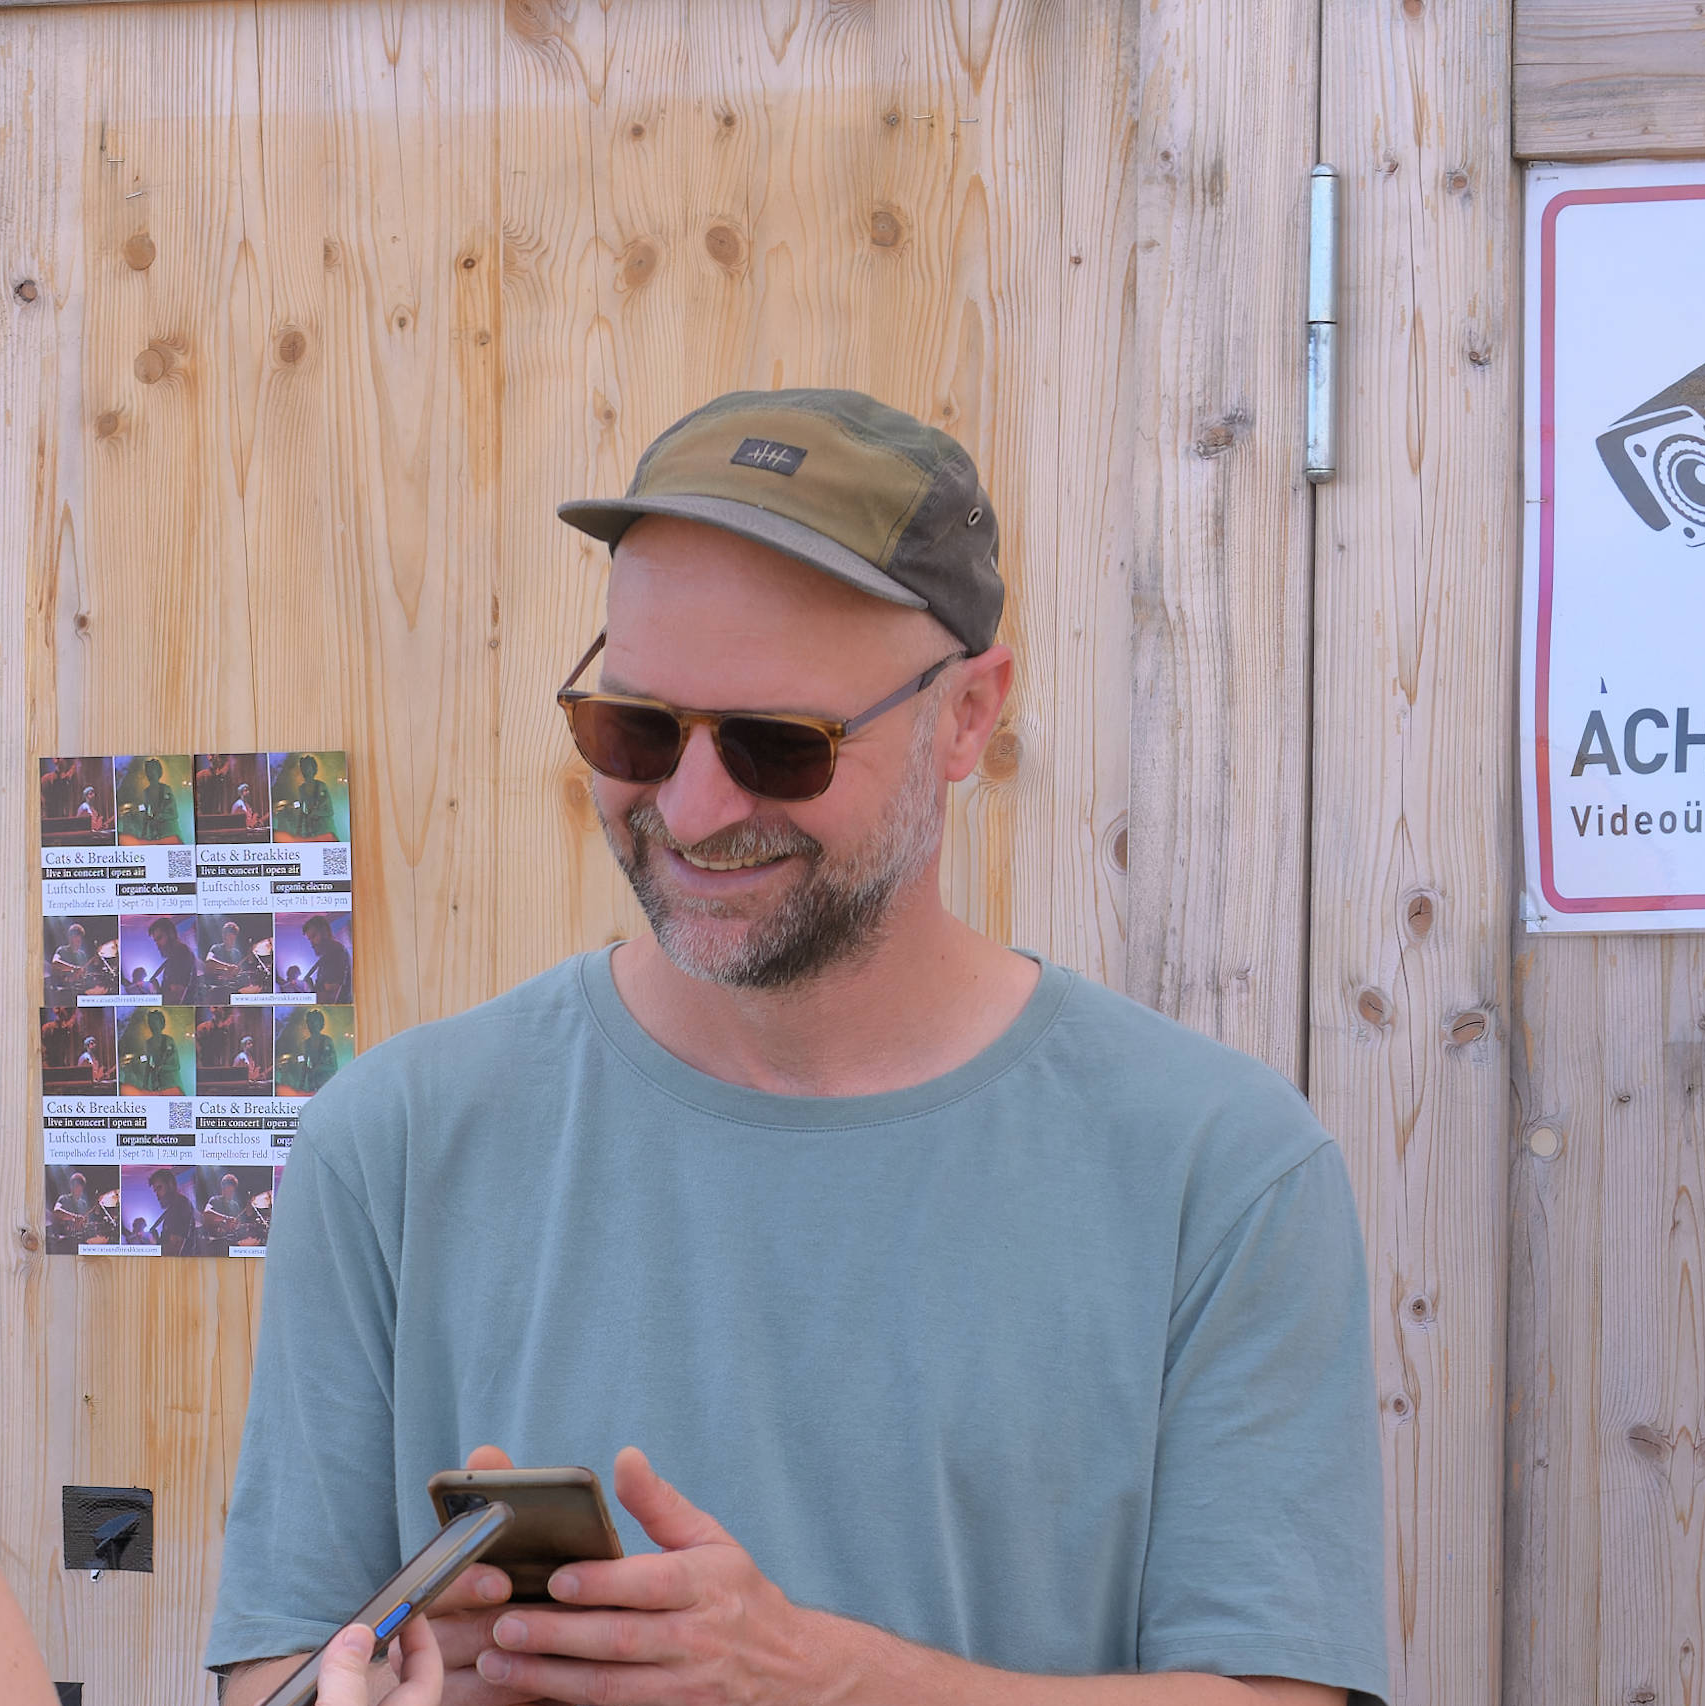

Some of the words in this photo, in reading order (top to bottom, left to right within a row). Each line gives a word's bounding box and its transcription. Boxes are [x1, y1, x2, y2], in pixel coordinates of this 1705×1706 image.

[46, 853, 71, 864] Cats
[75, 854, 84, 863] &
[89, 851, 145, 863] Breakkies
[201, 850, 226, 862] Cats
[230, 851, 239, 861] &
[244, 849, 300, 861] Breakkies
[46, 868, 61, 877] live
[63, 868, 71, 876] in
[74, 869, 104, 877] concert
[111, 869, 131, 878] open
[133, 867, 145, 876] air
[201, 866, 216, 875] live
[218, 866, 226, 874] in
[266, 867, 286, 876] open
[289, 865, 300, 873] air
[47, 883, 105, 894] Luftschloss
[121, 884, 150, 895] organic
[152, 884, 177, 892] electro
[202, 881, 260, 892] Luftschloss
[276, 882, 305, 893] organic
[307, 882, 333, 890] electro
[48, 900, 94, 910] Tempelhofer
[97, 899, 113, 907] Feld
[122, 899, 138, 909] Sept
[203, 898, 249, 908] Tempelhofer
[252, 897, 268, 905] Feld
[277, 896, 293, 907] Sept
[47, 1102, 73, 1113] Cats
[76, 1103, 85, 1113] &
[90, 1102, 147, 1113] Breakkies
[200, 1102, 226, 1114] Cats
[230, 1103, 240, 1113] &
[48, 1118, 62, 1126] live
[65, 1118, 72, 1126] in
[113, 1120, 132, 1128] open
[135, 1118, 145, 1126] air
[200, 1118, 216, 1126] live
[218, 1118, 226, 1126] in
[267, 1120, 287, 1129] open
[49, 1133, 106, 1143] Luftschloss
[123, 1136, 151, 1145] organic
[153, 1135, 178, 1143] electro
[201, 1133, 260, 1144] Luftschloss
[50, 1149, 95, 1160] Tempelhofer
[99, 1149, 114, 1157] Feld
[123, 1149, 139, 1160] Sept
[202, 1149, 248, 1159] Tempelhofer
[252, 1149, 267, 1158] Feld
